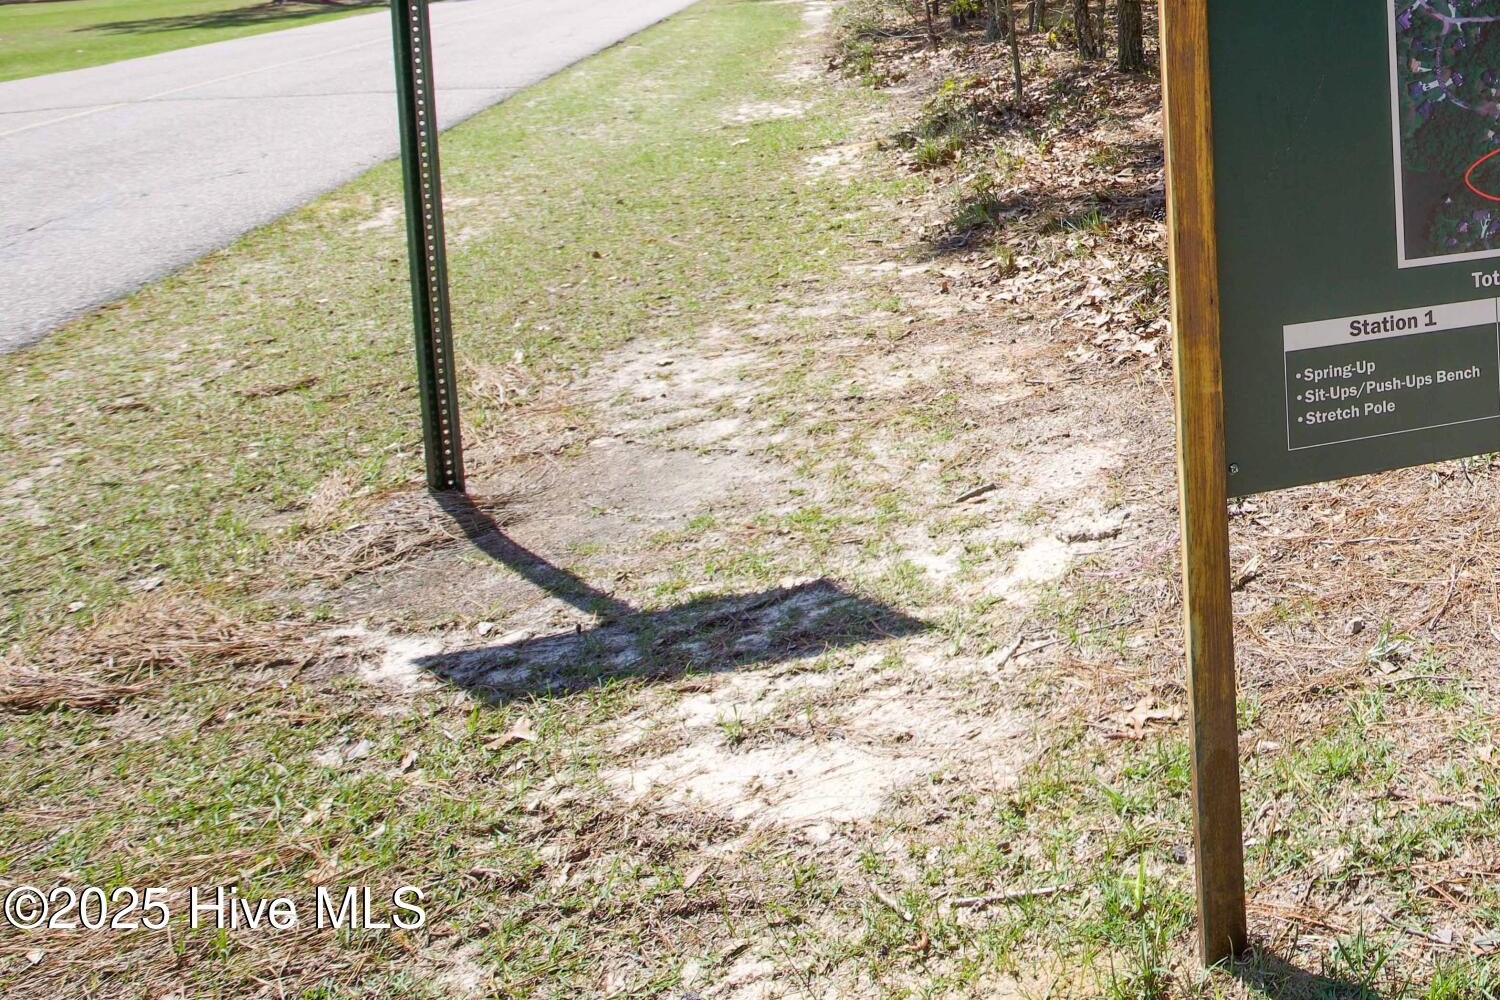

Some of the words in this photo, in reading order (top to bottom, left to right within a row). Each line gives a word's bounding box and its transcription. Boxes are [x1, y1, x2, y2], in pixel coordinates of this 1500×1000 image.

[1349, 315, 1418, 336] Station
[1424, 310, 1437, 327] 1
[1304, 360, 1376, 382] Spring-Up
[1304, 375, 1432, 403] Sit-Ups/Push-Ups
[1436, 366, 1480, 383] Bench
[1305, 405, 1360, 425] Stretch
[1364, 400, 1396, 416] Pole
